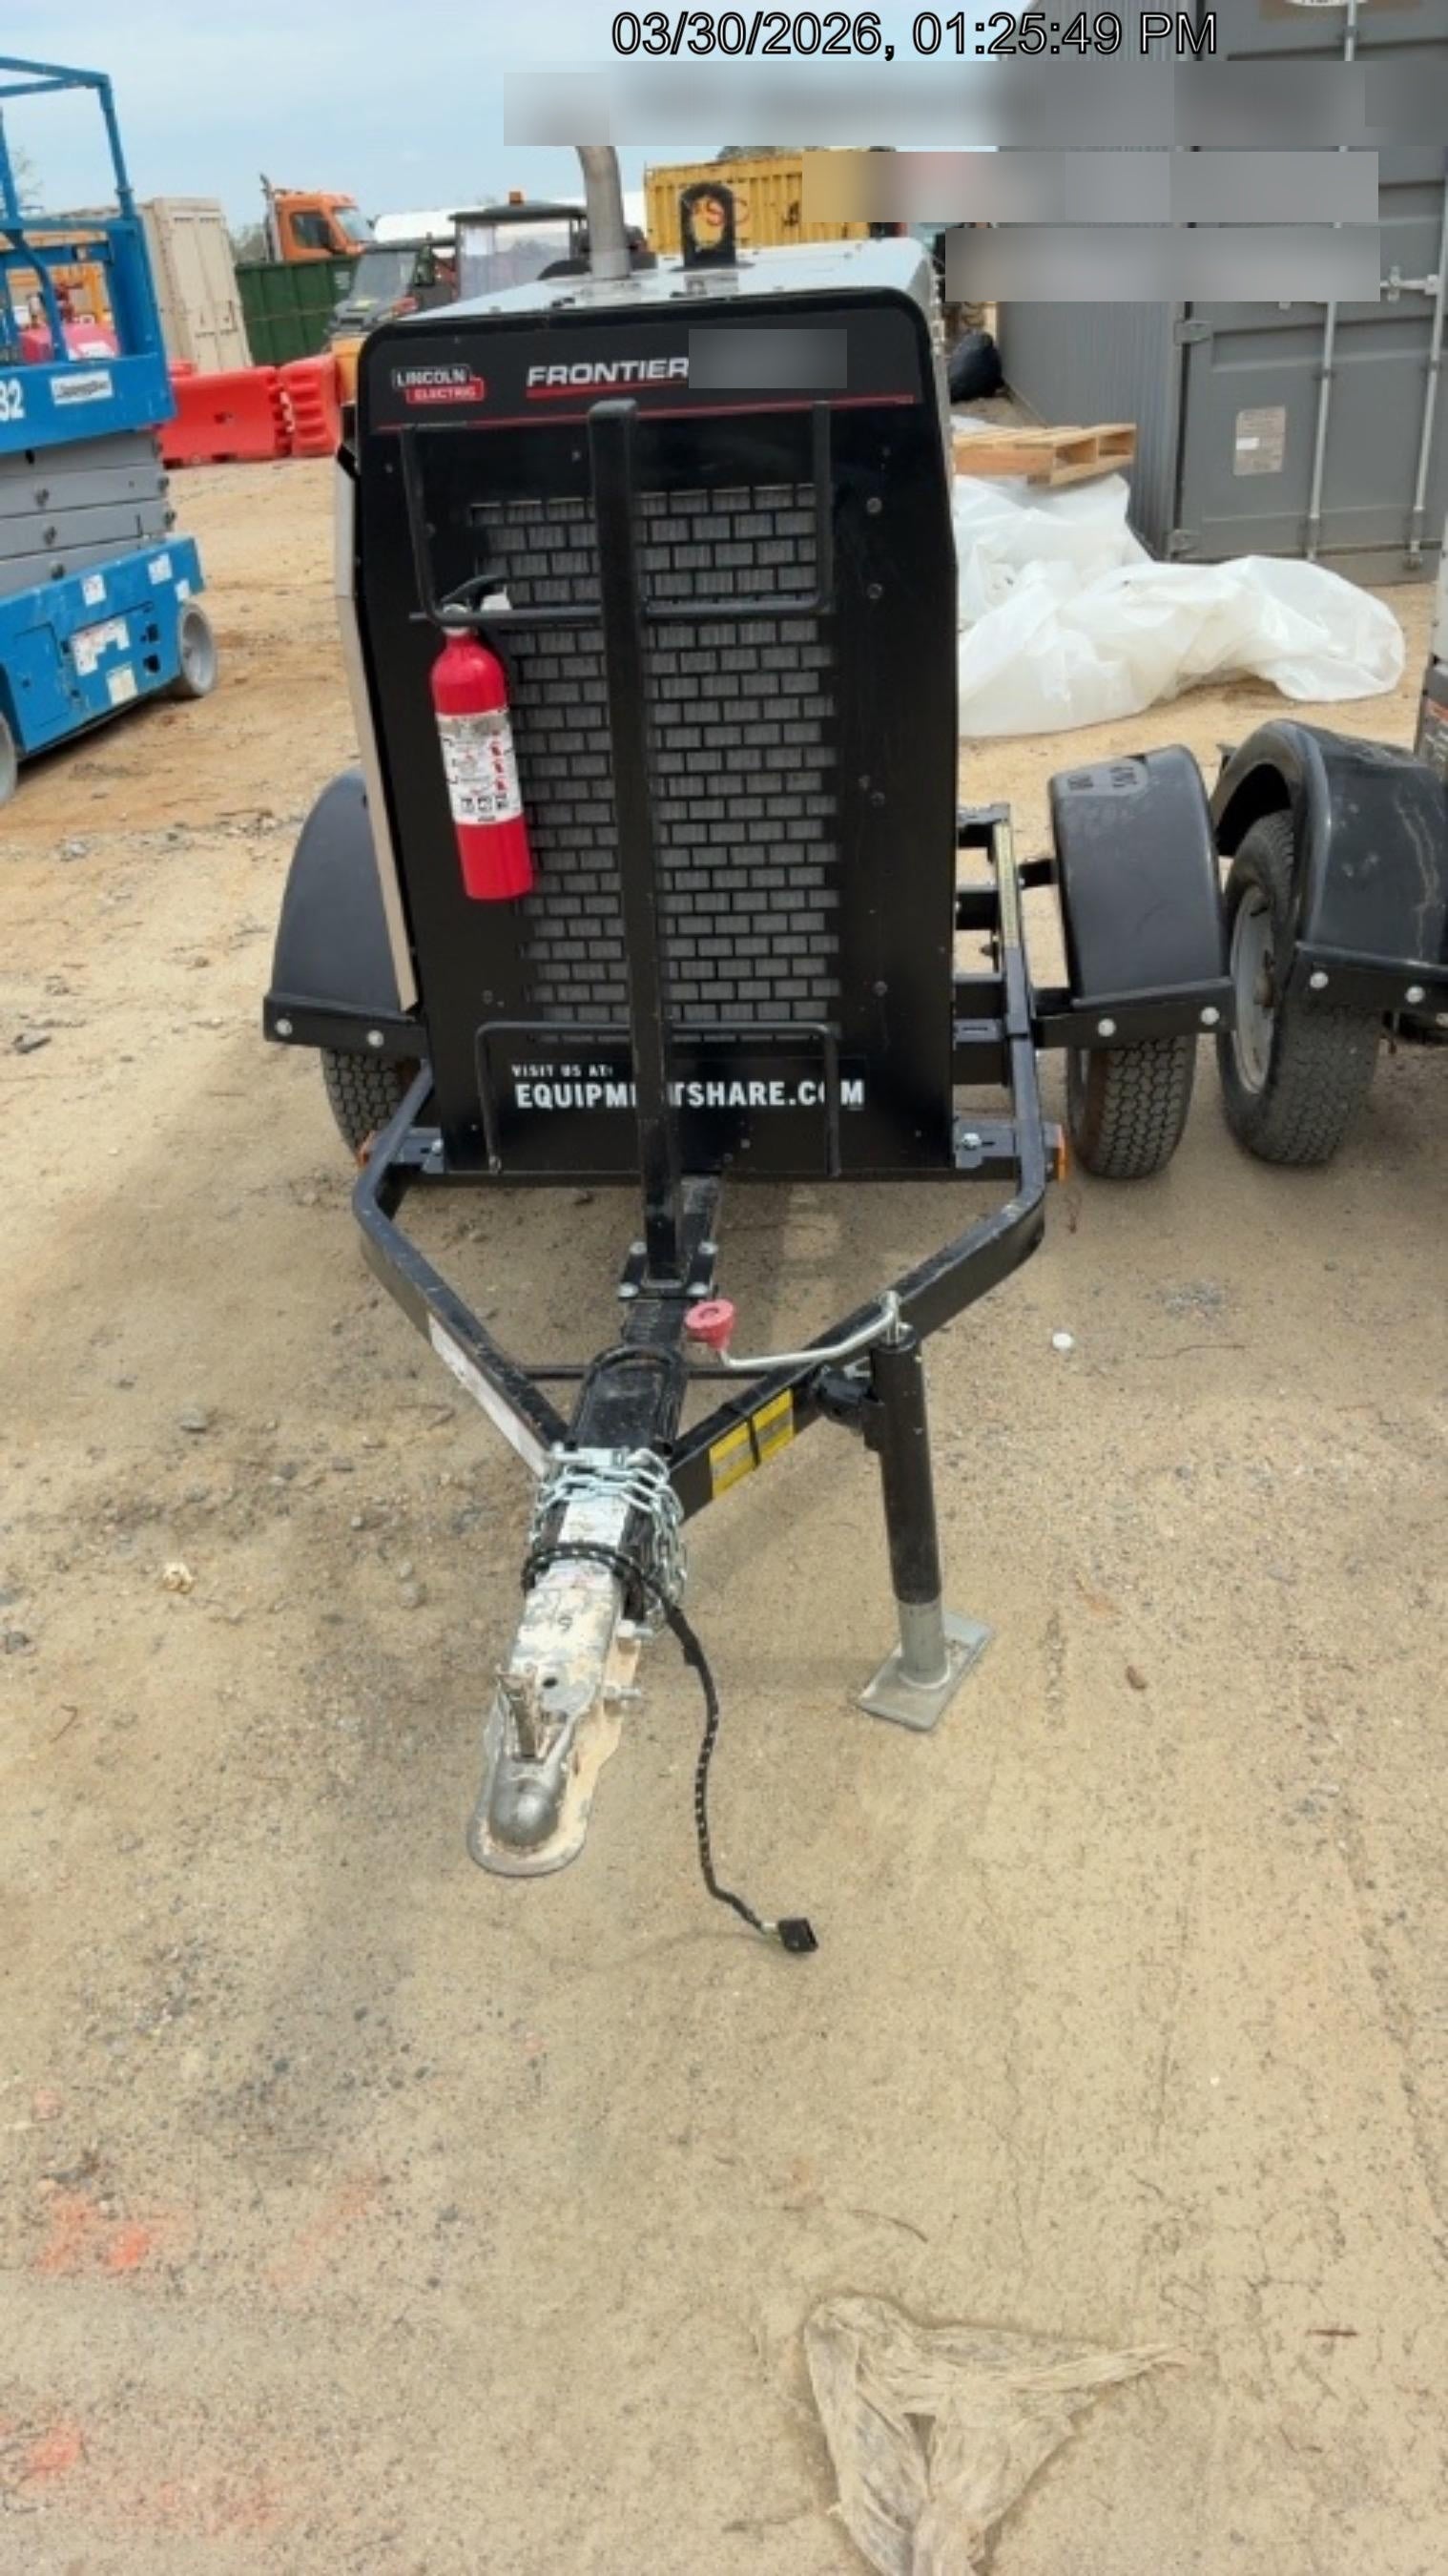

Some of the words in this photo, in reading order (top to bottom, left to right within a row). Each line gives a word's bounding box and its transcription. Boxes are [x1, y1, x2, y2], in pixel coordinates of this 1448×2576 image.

[396, 367, 467, 387] LINCOLN
[526, 356, 689, 387] FRONTIER
[413, 384, 476, 401] ELECTRIC
[510, 1064, 554, 1078] VISIT
[560, 1064, 582, 1078] US
[588, 1064, 613, 1078] AT:
[515, 1079, 864, 1111] EQUIPMTSHARE.CM
